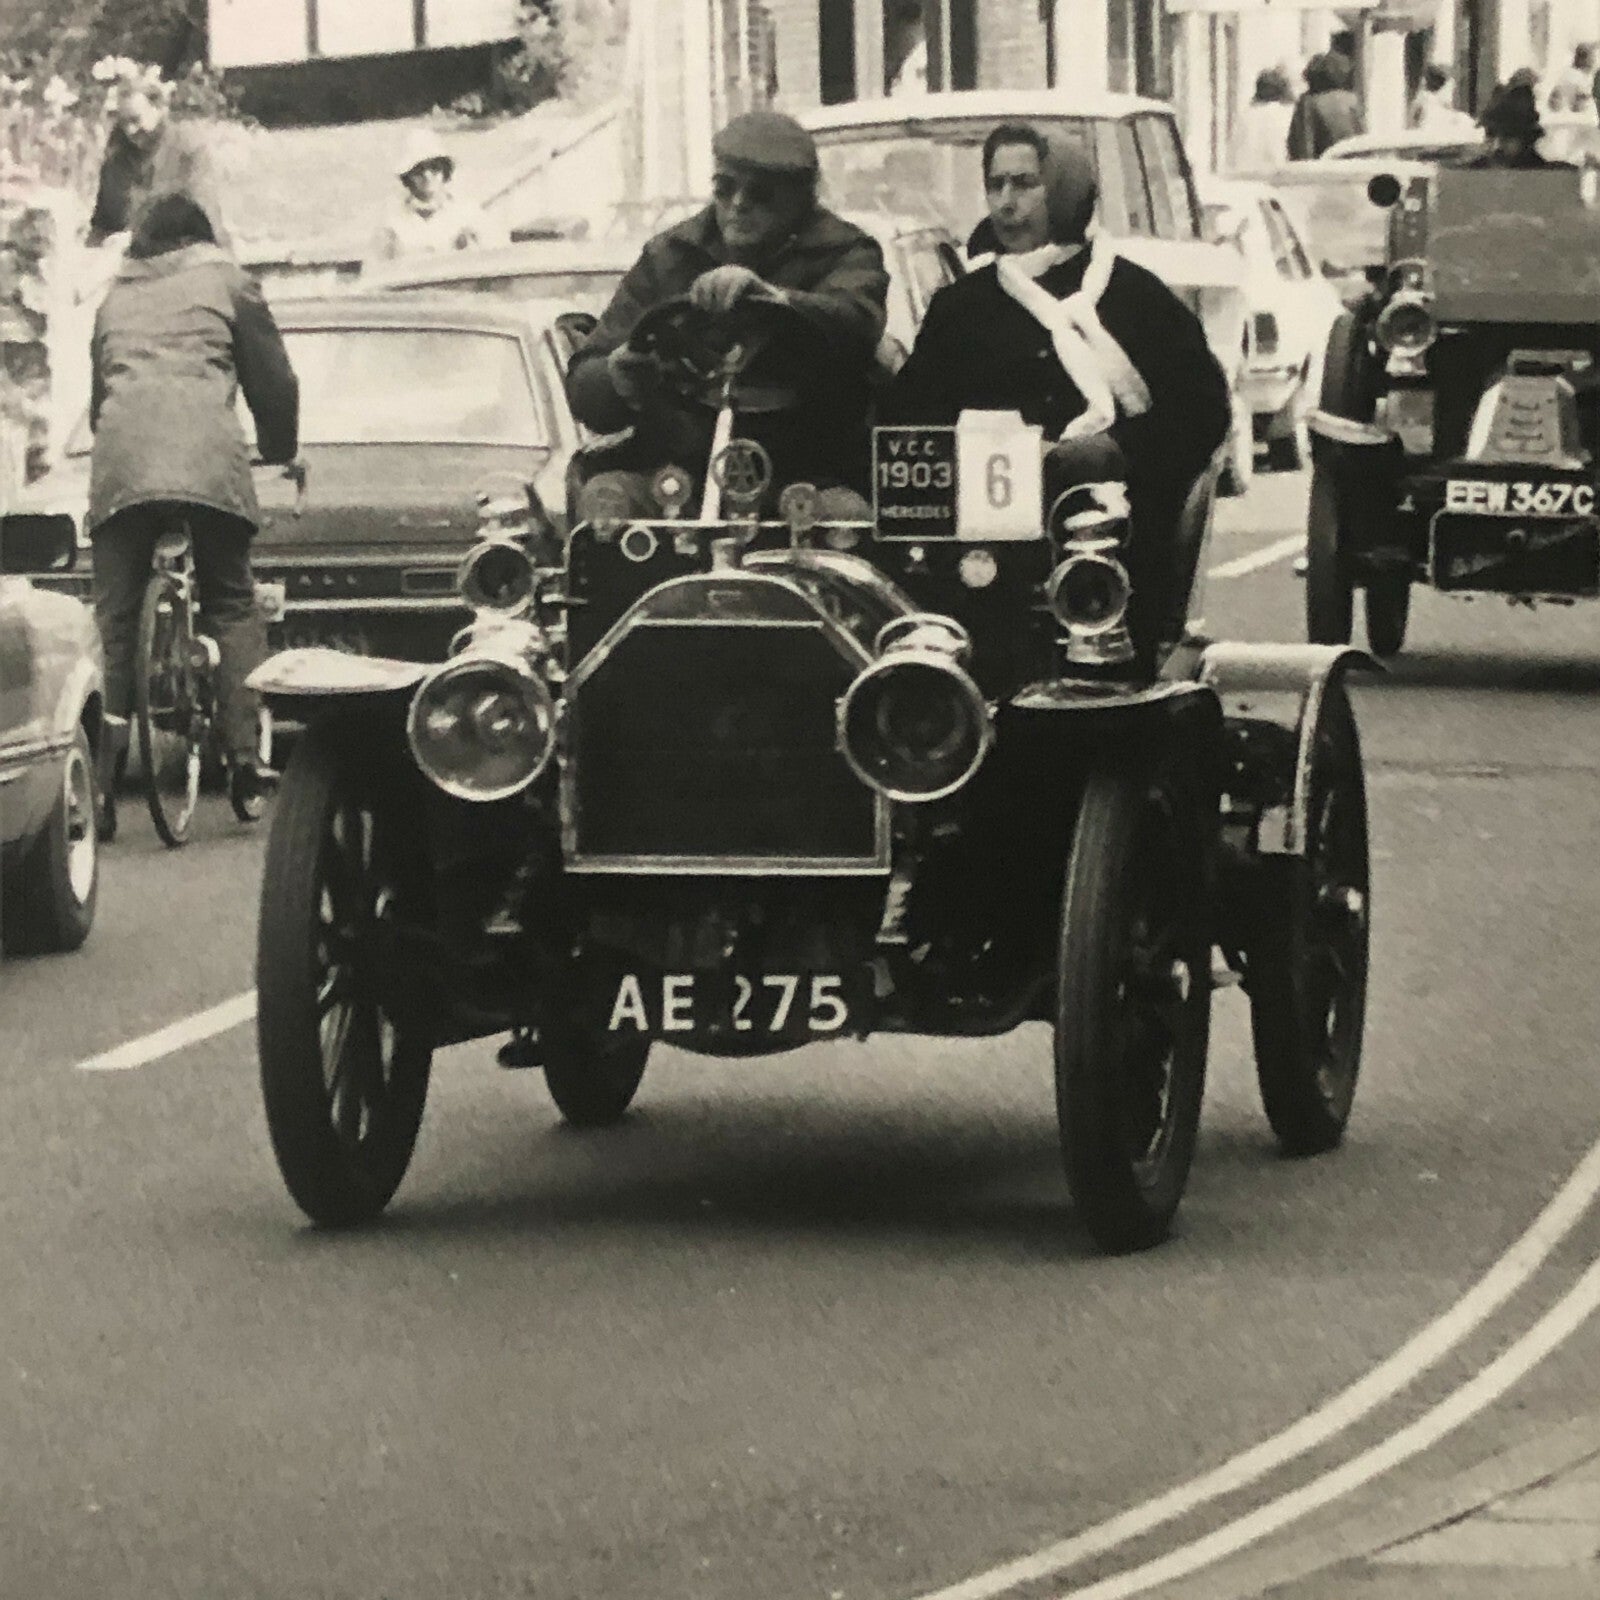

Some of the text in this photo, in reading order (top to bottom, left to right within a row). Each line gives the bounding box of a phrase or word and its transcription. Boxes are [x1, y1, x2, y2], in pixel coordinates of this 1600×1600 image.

[879, 461, 952, 488] 1903
[986, 453, 1012, 509] 6
[608, 974, 849, 1031] AE 275
